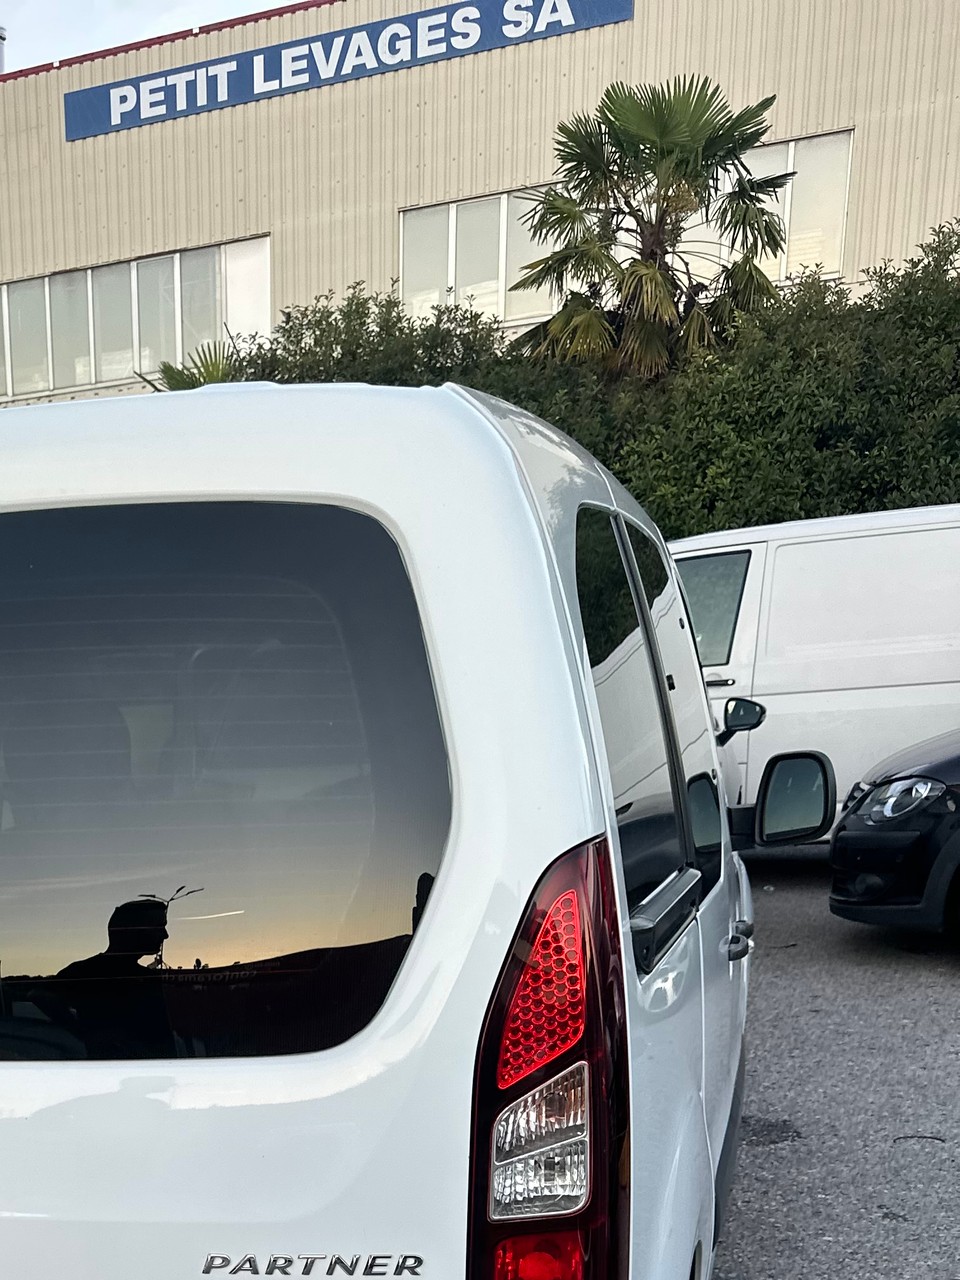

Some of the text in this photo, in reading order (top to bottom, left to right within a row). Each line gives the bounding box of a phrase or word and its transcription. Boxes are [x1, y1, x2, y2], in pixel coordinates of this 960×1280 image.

[109, 0, 576, 126] PETIT LEVAGES SA
[202, 1252, 425, 1277] PARTNER
